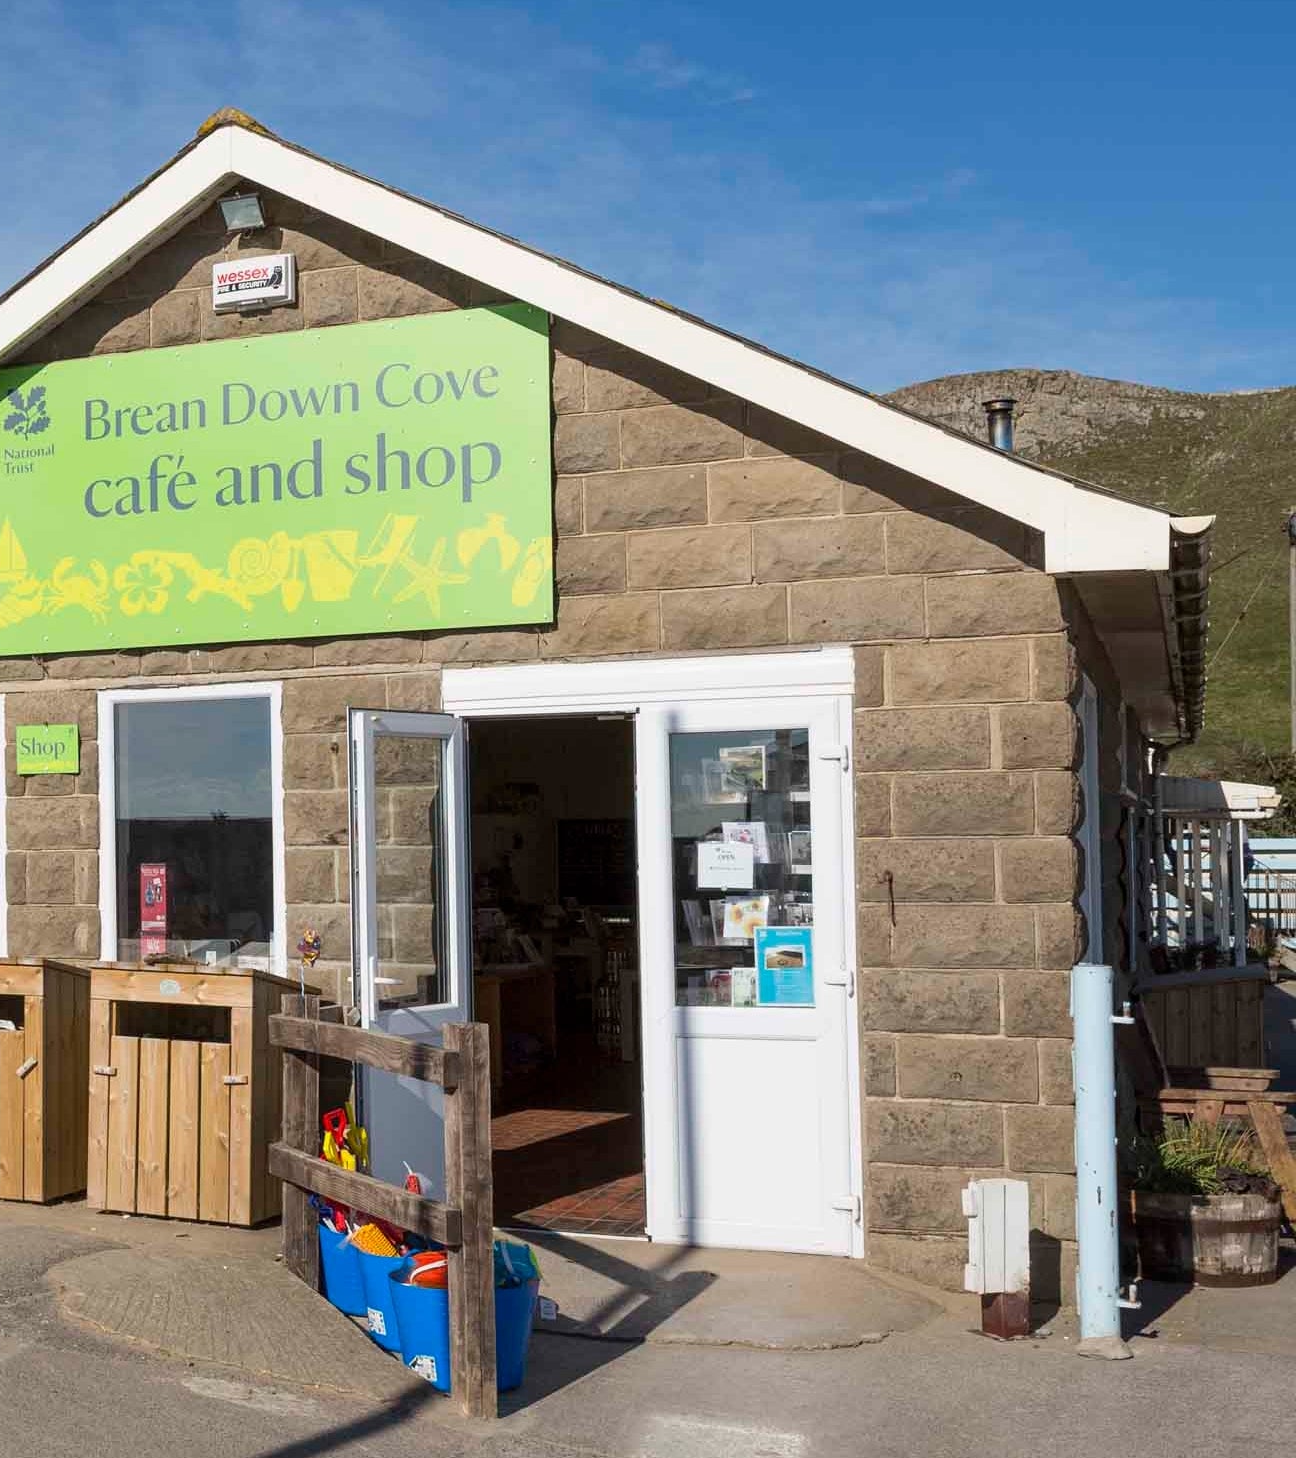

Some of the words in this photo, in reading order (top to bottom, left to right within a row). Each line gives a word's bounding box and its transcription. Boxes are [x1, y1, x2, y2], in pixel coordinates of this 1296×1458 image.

[217, 267, 269, 284] wessex
[238, 280, 267, 290] SECURITY
[84, 398, 206, 441] Brean
[222, 381, 360, 426] Down
[375, 362, 500, 409] Cove
[4, 443, 55, 461] National
[4, 462, 34, 475] Trust
[84, 448, 198, 518] café
[215, 439, 324, 507] and
[345, 432, 502, 503] shop
[20, 737, 65, 760] Shop
